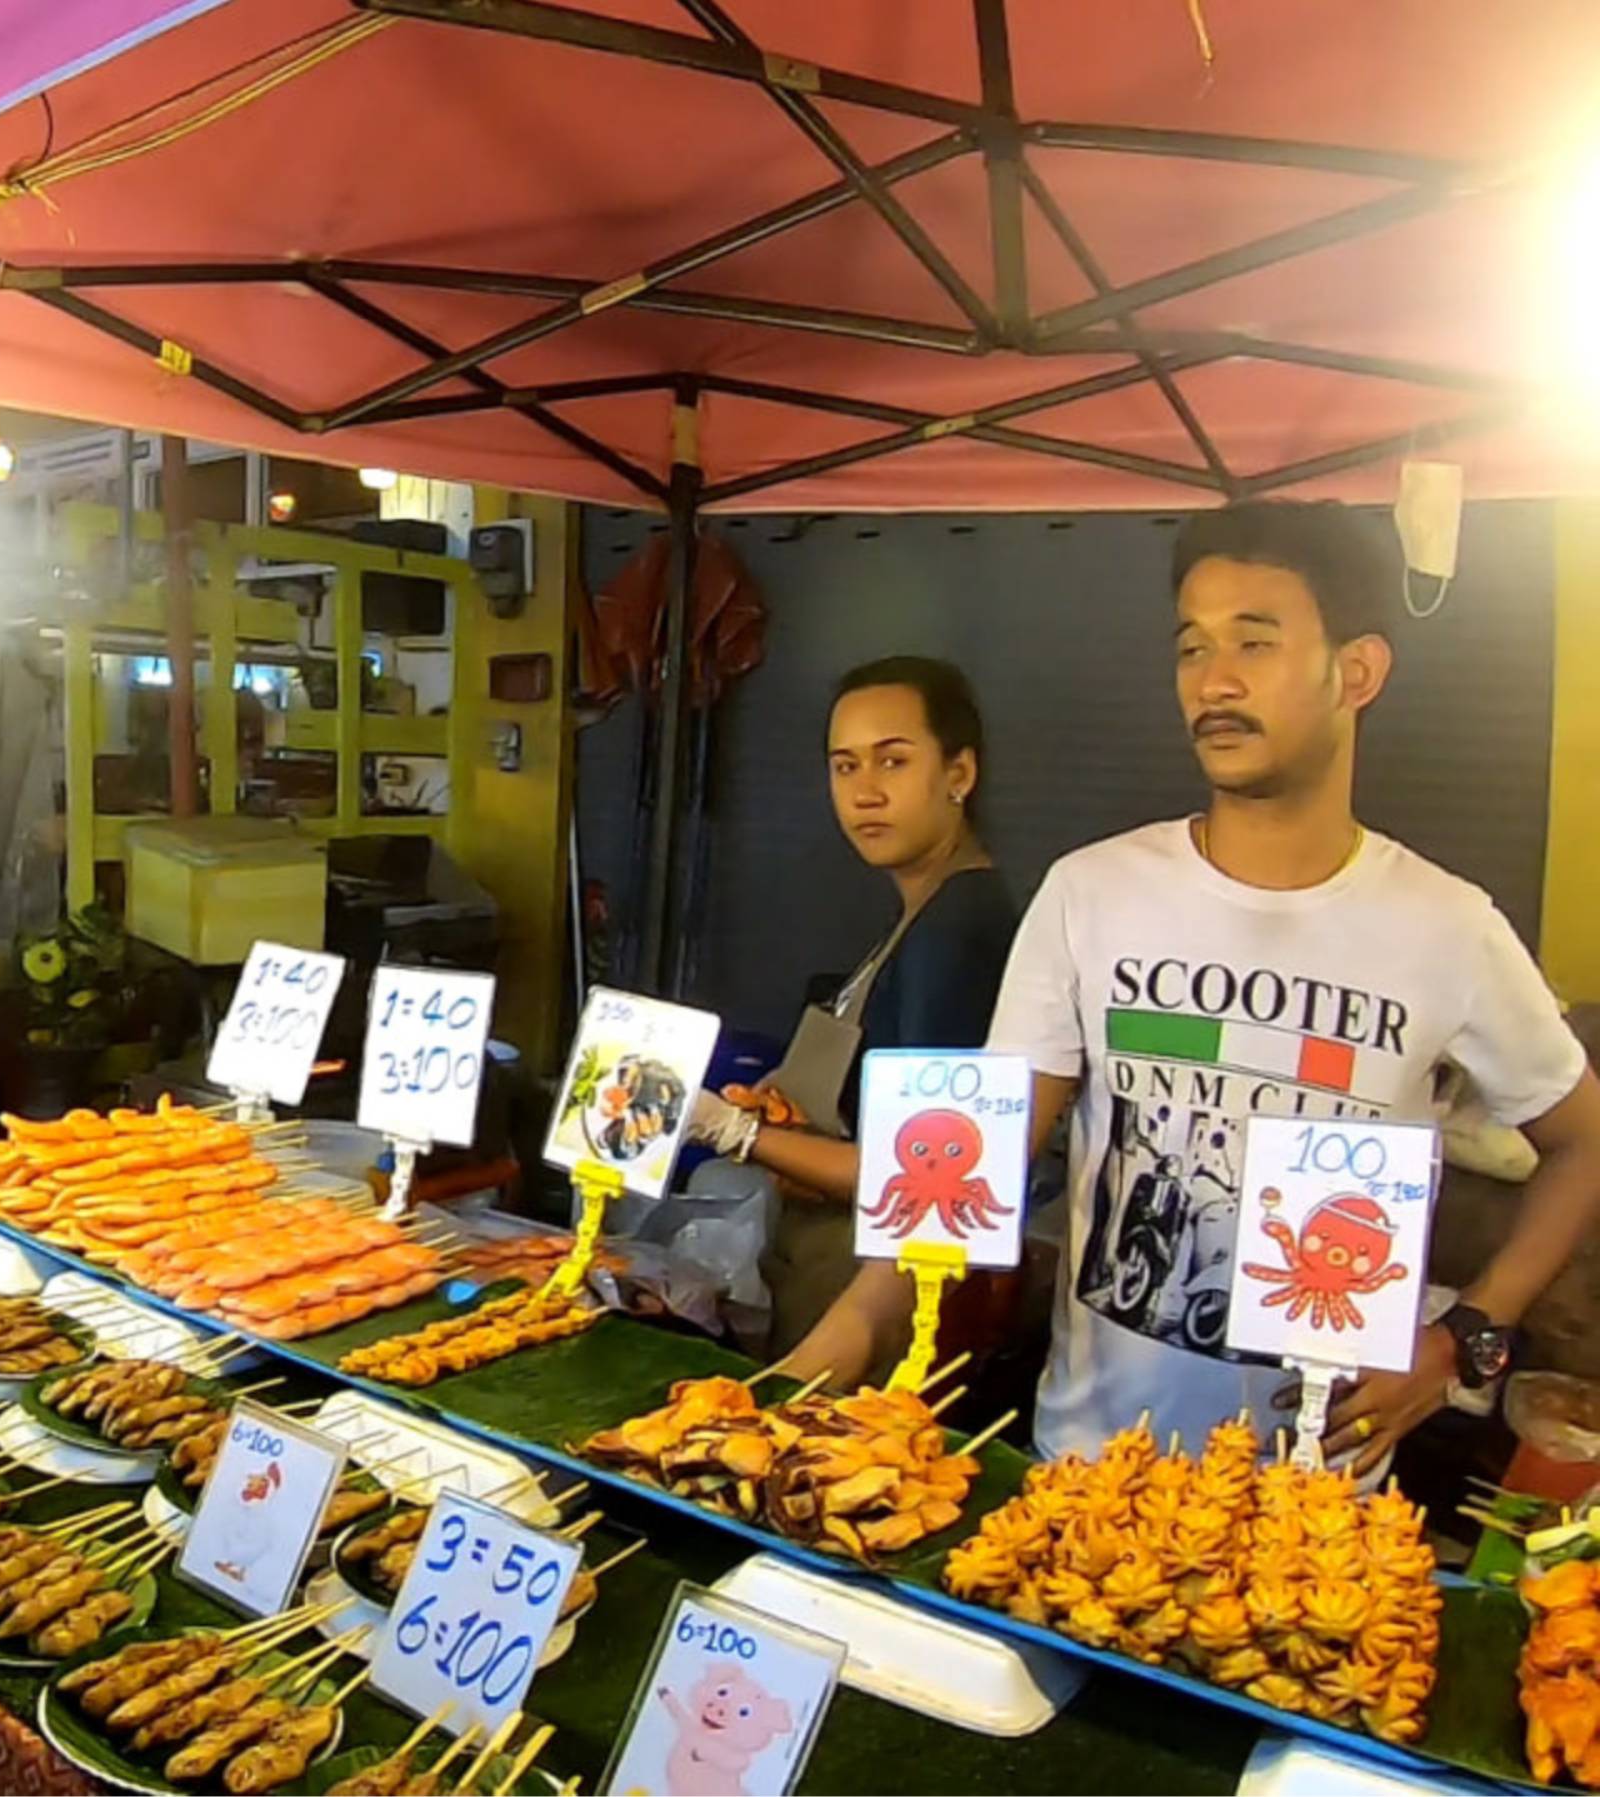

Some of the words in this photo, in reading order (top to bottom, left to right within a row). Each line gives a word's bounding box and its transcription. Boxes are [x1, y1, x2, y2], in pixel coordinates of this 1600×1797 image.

[1111, 957, 1408, 1056] SCOOTER
[1286, 1125, 1388, 1180] 100
[425, 1515, 561, 1606] 3=50
